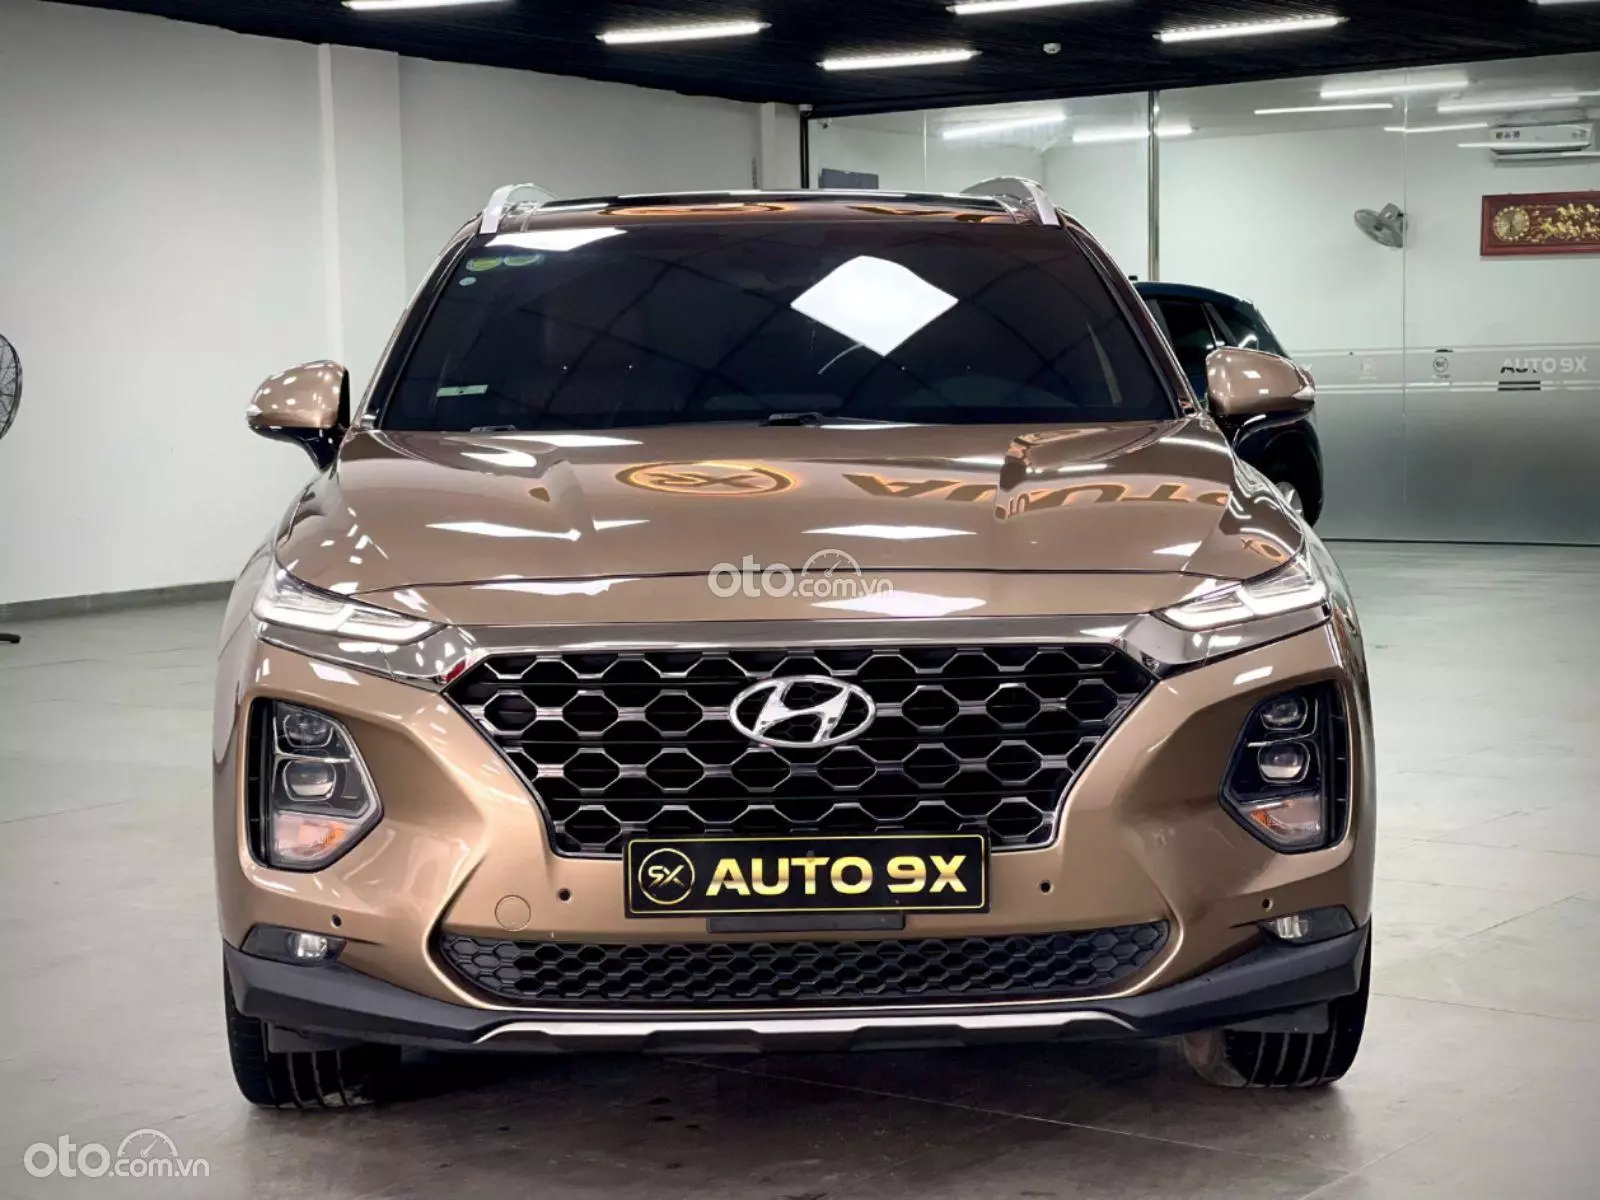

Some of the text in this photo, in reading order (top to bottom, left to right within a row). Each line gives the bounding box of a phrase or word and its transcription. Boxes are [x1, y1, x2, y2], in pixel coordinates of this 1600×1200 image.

[1500, 356, 1588, 374] AUTO 9X
[647, 855, 967, 896] 9X AUTO 9X
